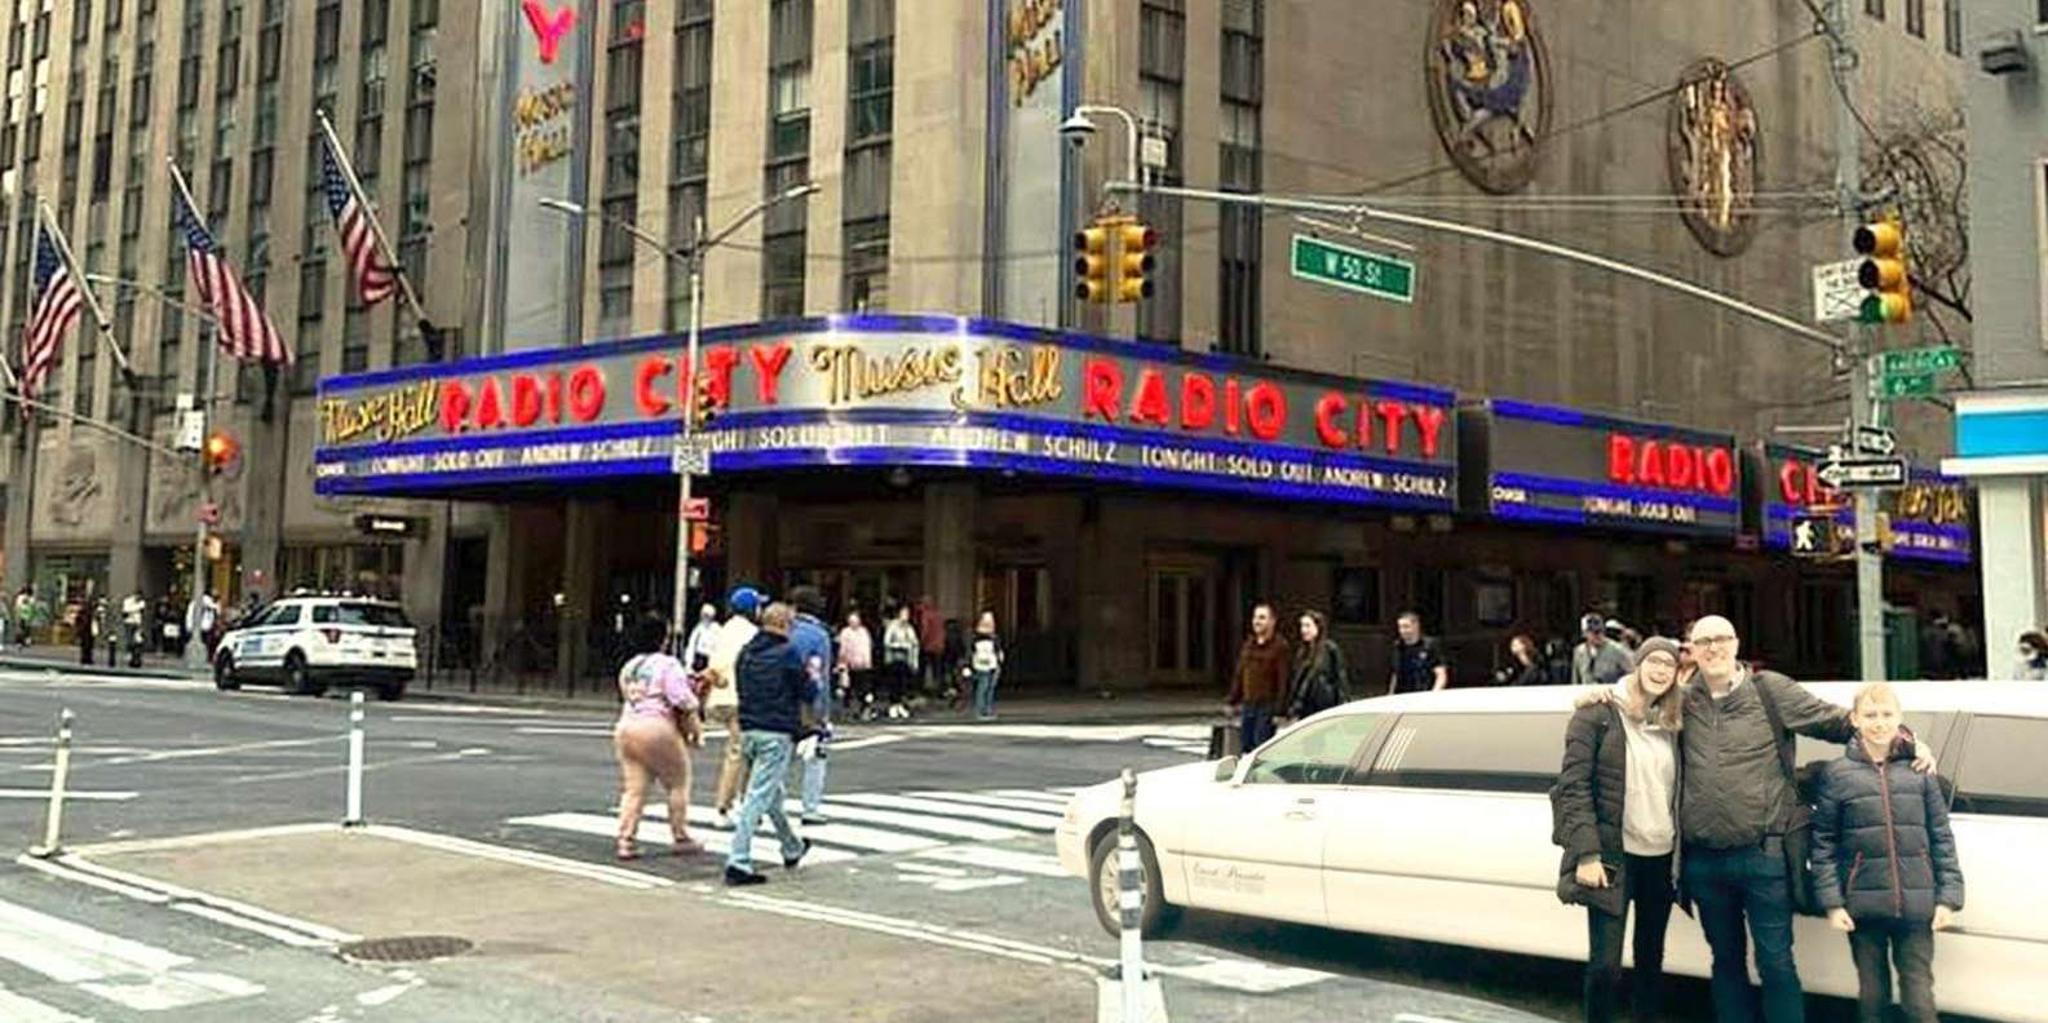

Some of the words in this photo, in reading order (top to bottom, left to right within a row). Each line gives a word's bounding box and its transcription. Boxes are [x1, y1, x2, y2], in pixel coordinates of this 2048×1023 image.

[1325, 251, 1339, 275] W
[1342, 255, 1362, 281] 50
[318, 397, 386, 442] Music
[376, 378, 441, 442] Hall
[441, 365, 605, 434] RADIO
[634, 344, 793, 415] CITY
[811, 345, 964, 407] Music
[953, 344, 1063, 408] Hall
[1085, 360, 1287, 440] RADIO
[1316, 389, 1446, 460] CITY
[1043, 435, 1117, 462] SCHULZ
[1609, 435, 1733, 494] RADIO
[1226, 453, 1273, 480] SOLD
[1280, 459, 1312, 484] OUT
[1391, 472, 1447, 497] SCHULZ
